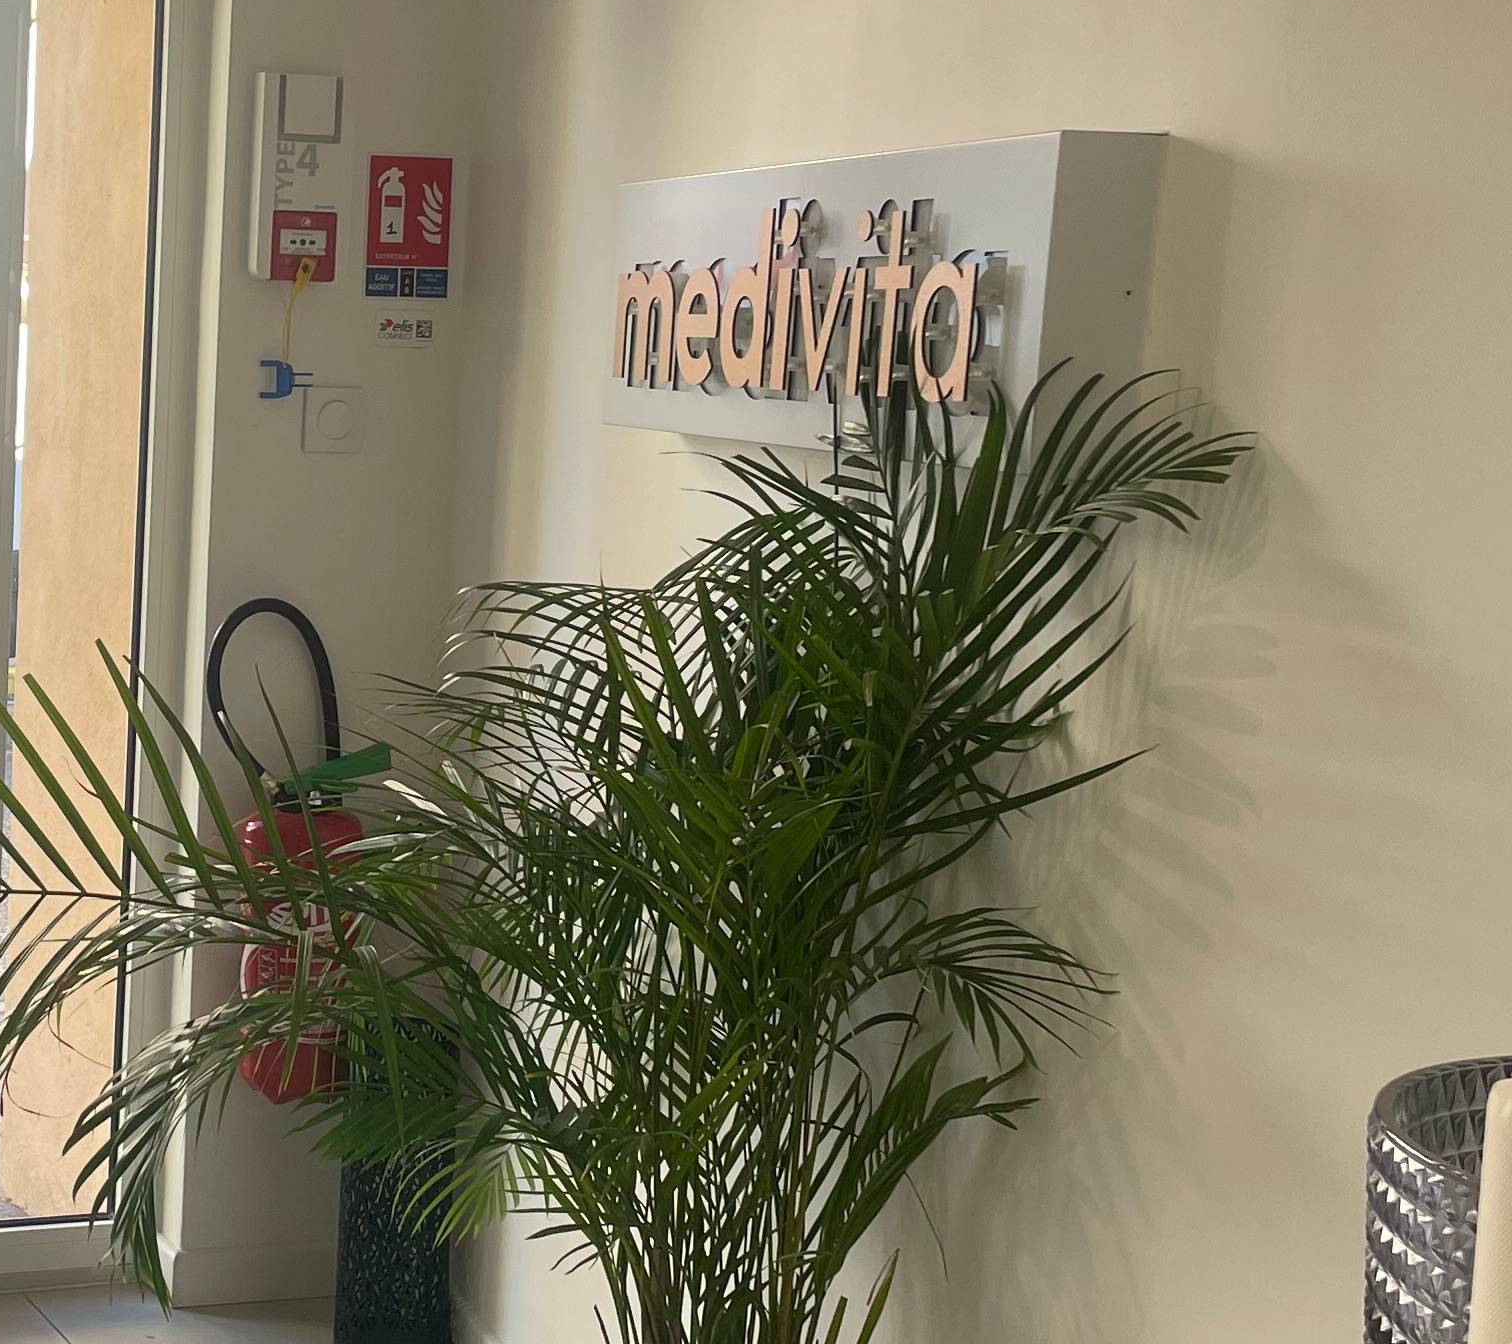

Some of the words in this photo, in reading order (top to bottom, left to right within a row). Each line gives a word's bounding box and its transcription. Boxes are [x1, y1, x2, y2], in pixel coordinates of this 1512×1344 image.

[274, 142, 296, 210] TYPE
[296, 144, 320, 177] 4
[374, 273, 390, 281] EAU
[613, 207, 980, 402] medivita
[392, 319, 414, 332] elis
